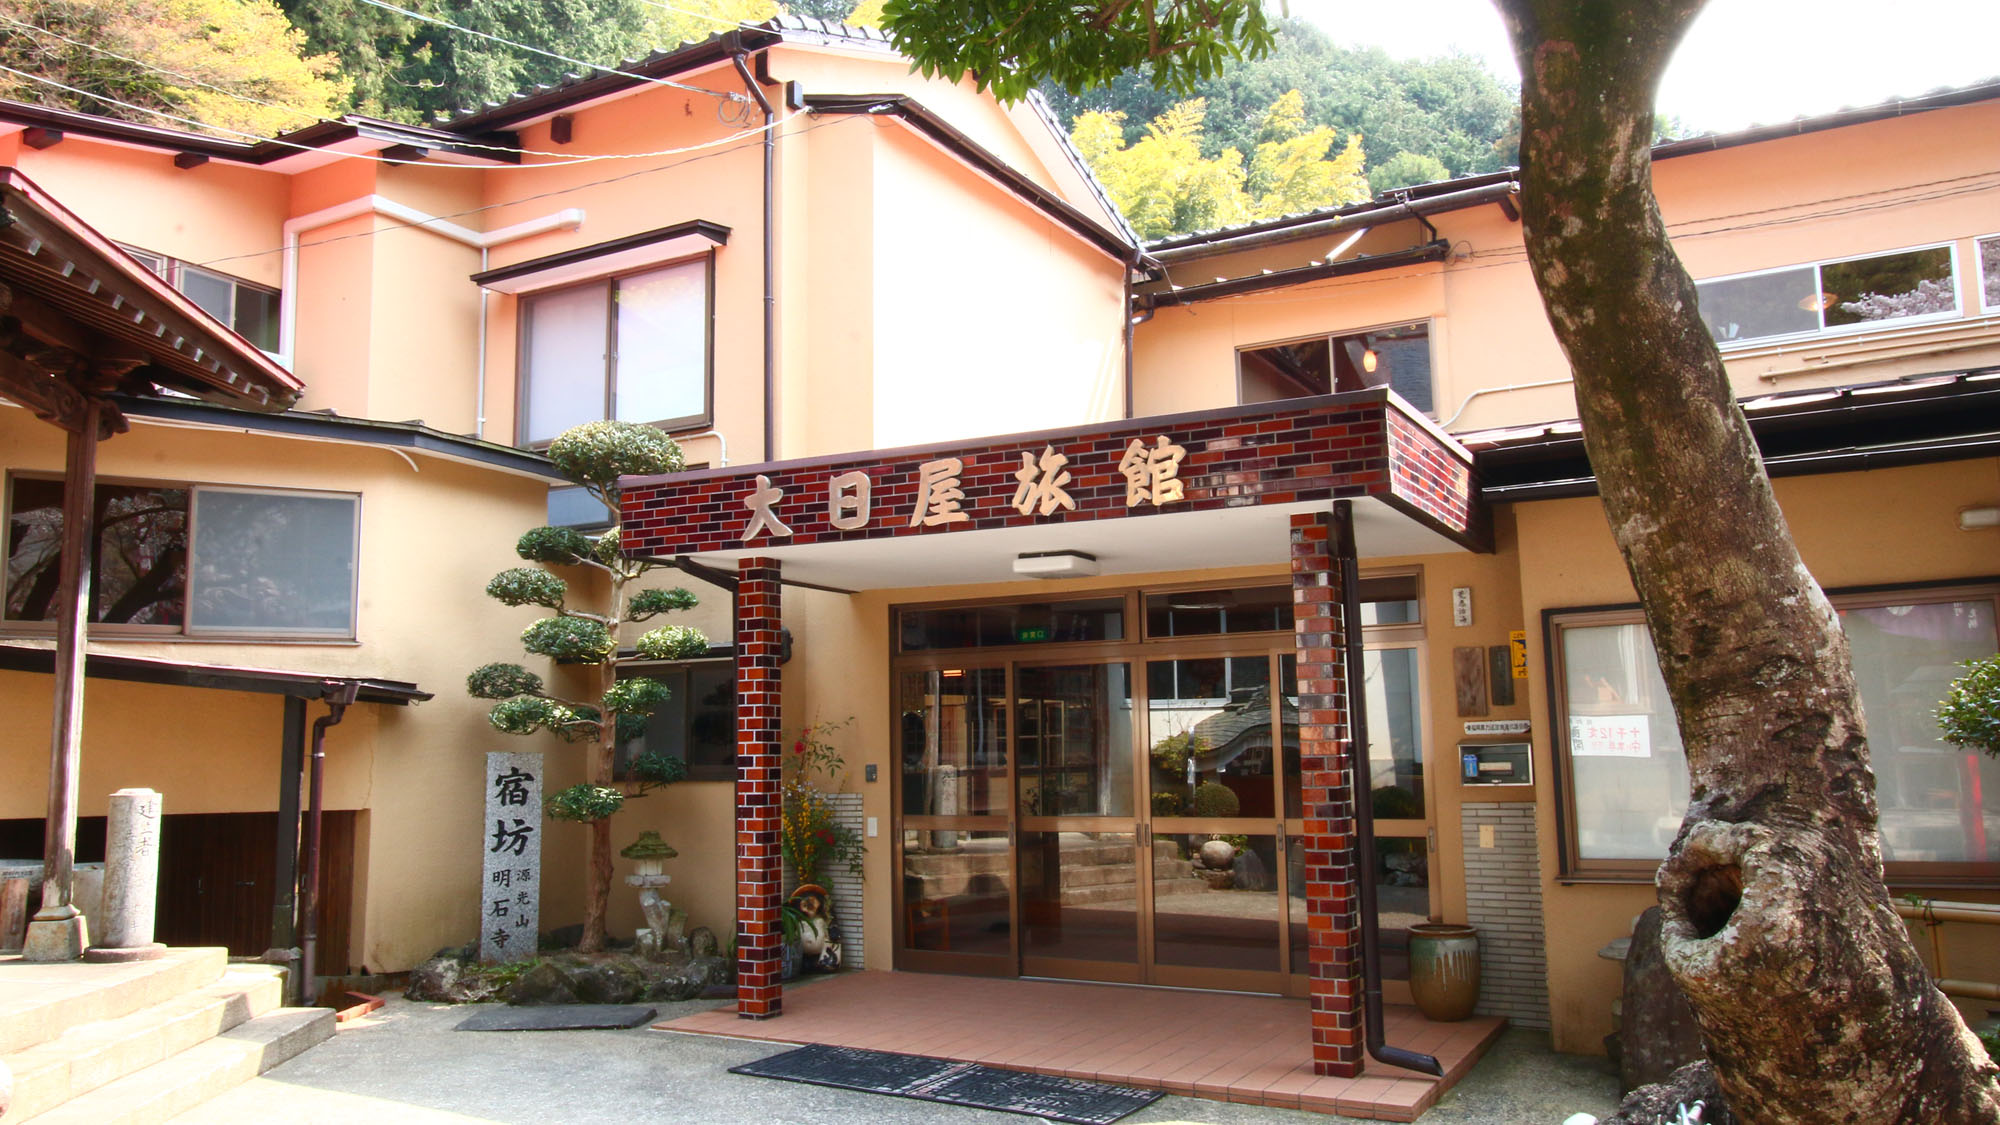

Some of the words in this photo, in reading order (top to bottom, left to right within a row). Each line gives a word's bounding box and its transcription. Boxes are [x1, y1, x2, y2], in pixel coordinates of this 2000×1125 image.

[740, 435, 1187, 542] 大日屋旅館
[491, 766, 534, 857] 宿坊
[487, 869, 511, 950] 明石寺
[515, 869, 532, 928] 源光山
